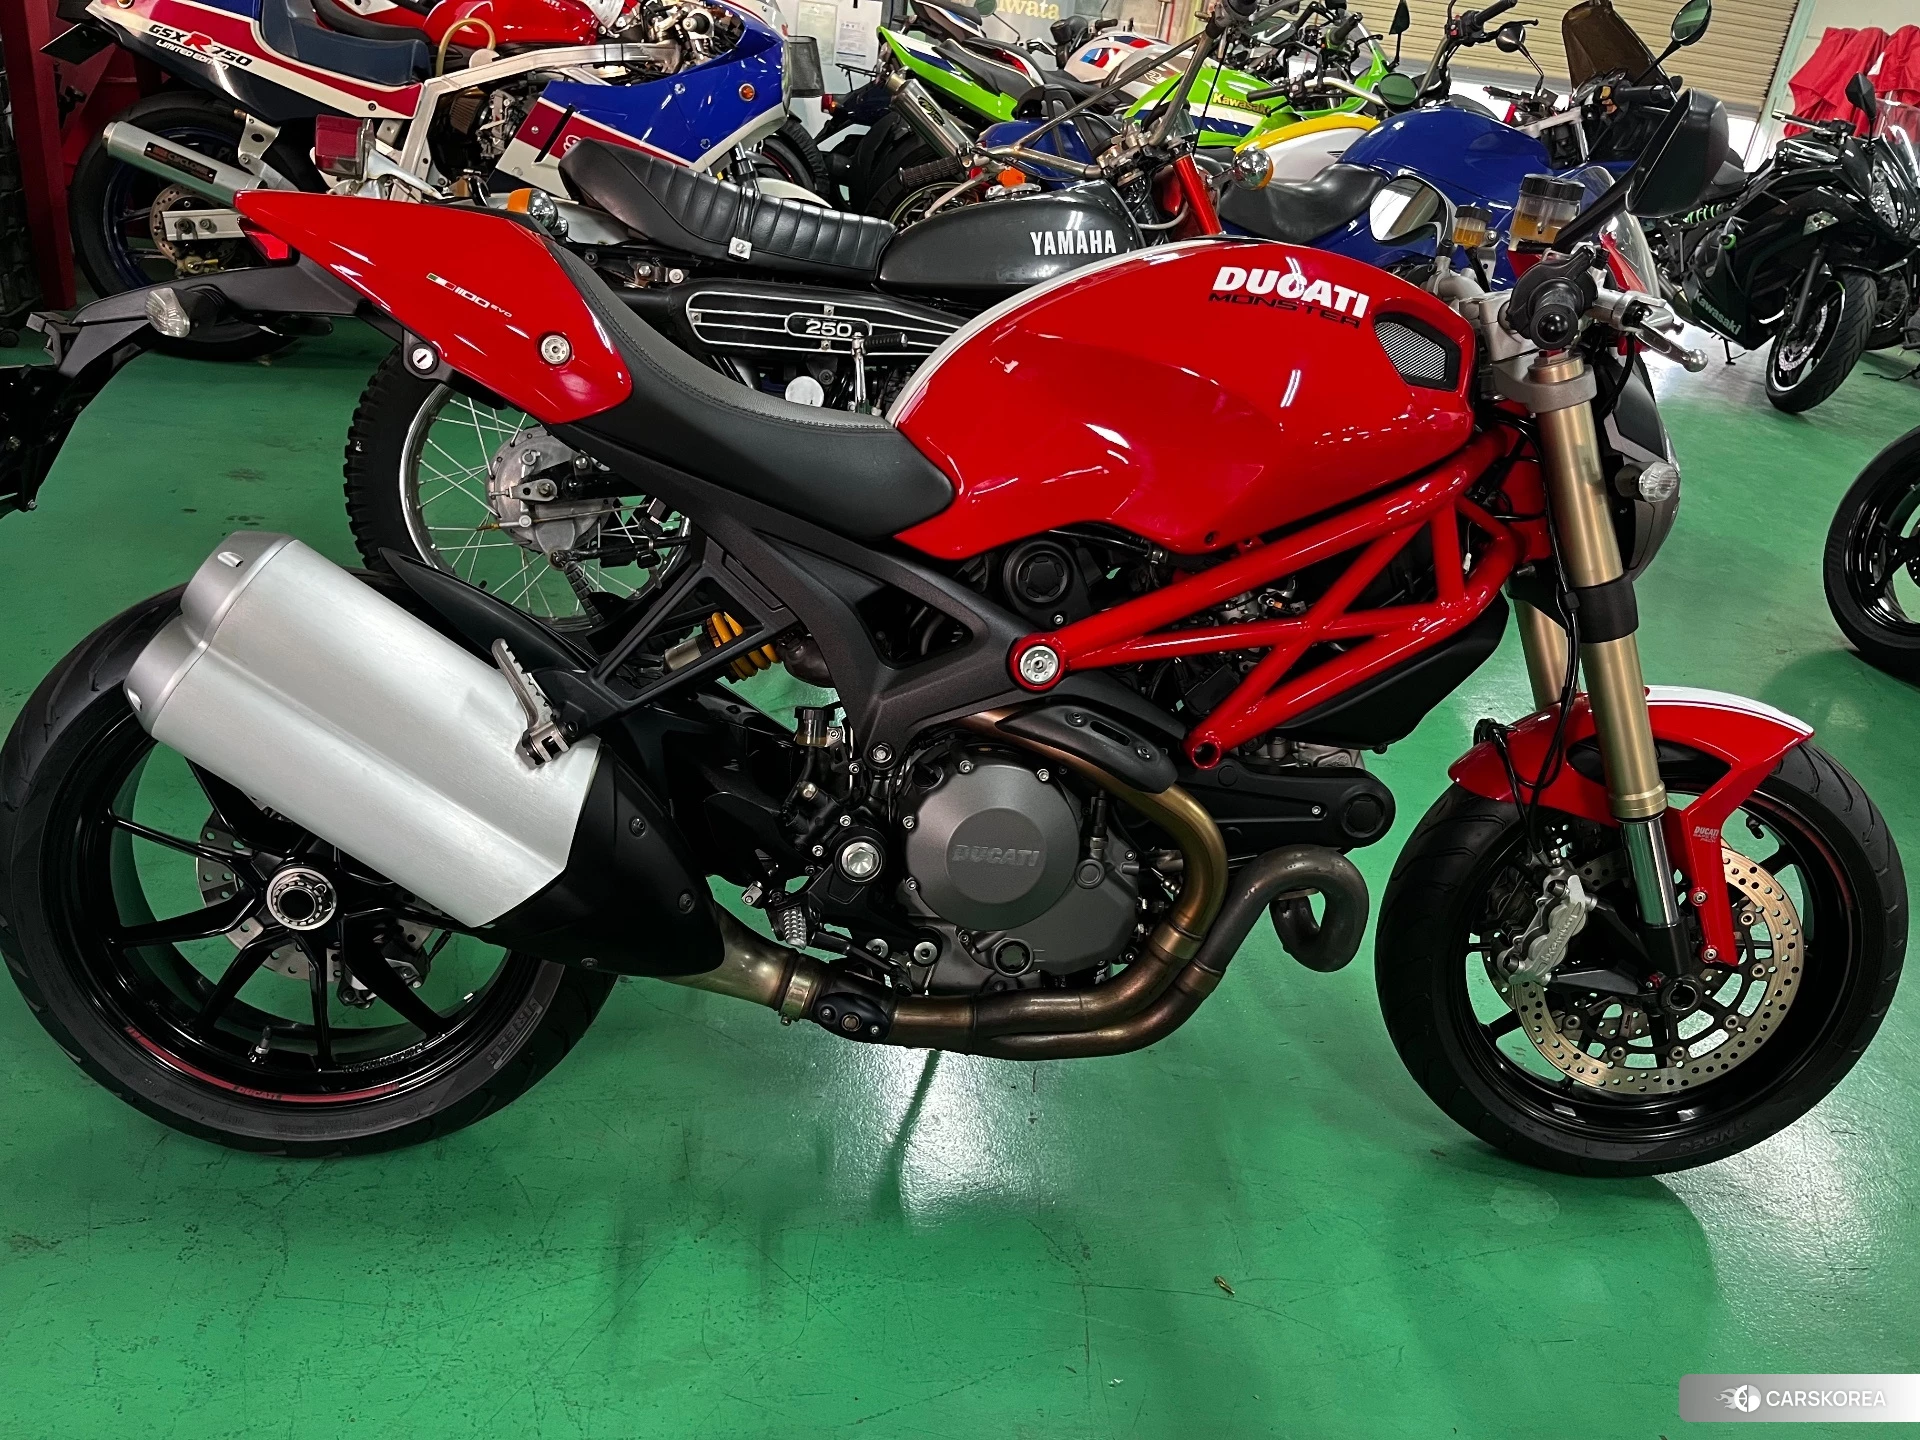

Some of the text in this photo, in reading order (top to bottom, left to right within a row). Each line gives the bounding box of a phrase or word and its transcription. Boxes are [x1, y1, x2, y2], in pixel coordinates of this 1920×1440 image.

[156, 39, 230, 70] LIMITED EDITIN
[1029, 230, 1117, 255] YAMAHA
[454, 286, 513, 318] 1100 EVO
[1212, 266, 1370, 319] DUCATI
[1208, 293, 1361, 329] MONSTER
[1693, 288, 1742, 336] Kawasaki
[805, 319, 853, 338] 250
[1693, 825, 1720, 837] DUCATI
[952, 844, 1040, 867] DUCATI
[237, 1086, 279, 1100] DUCATI
